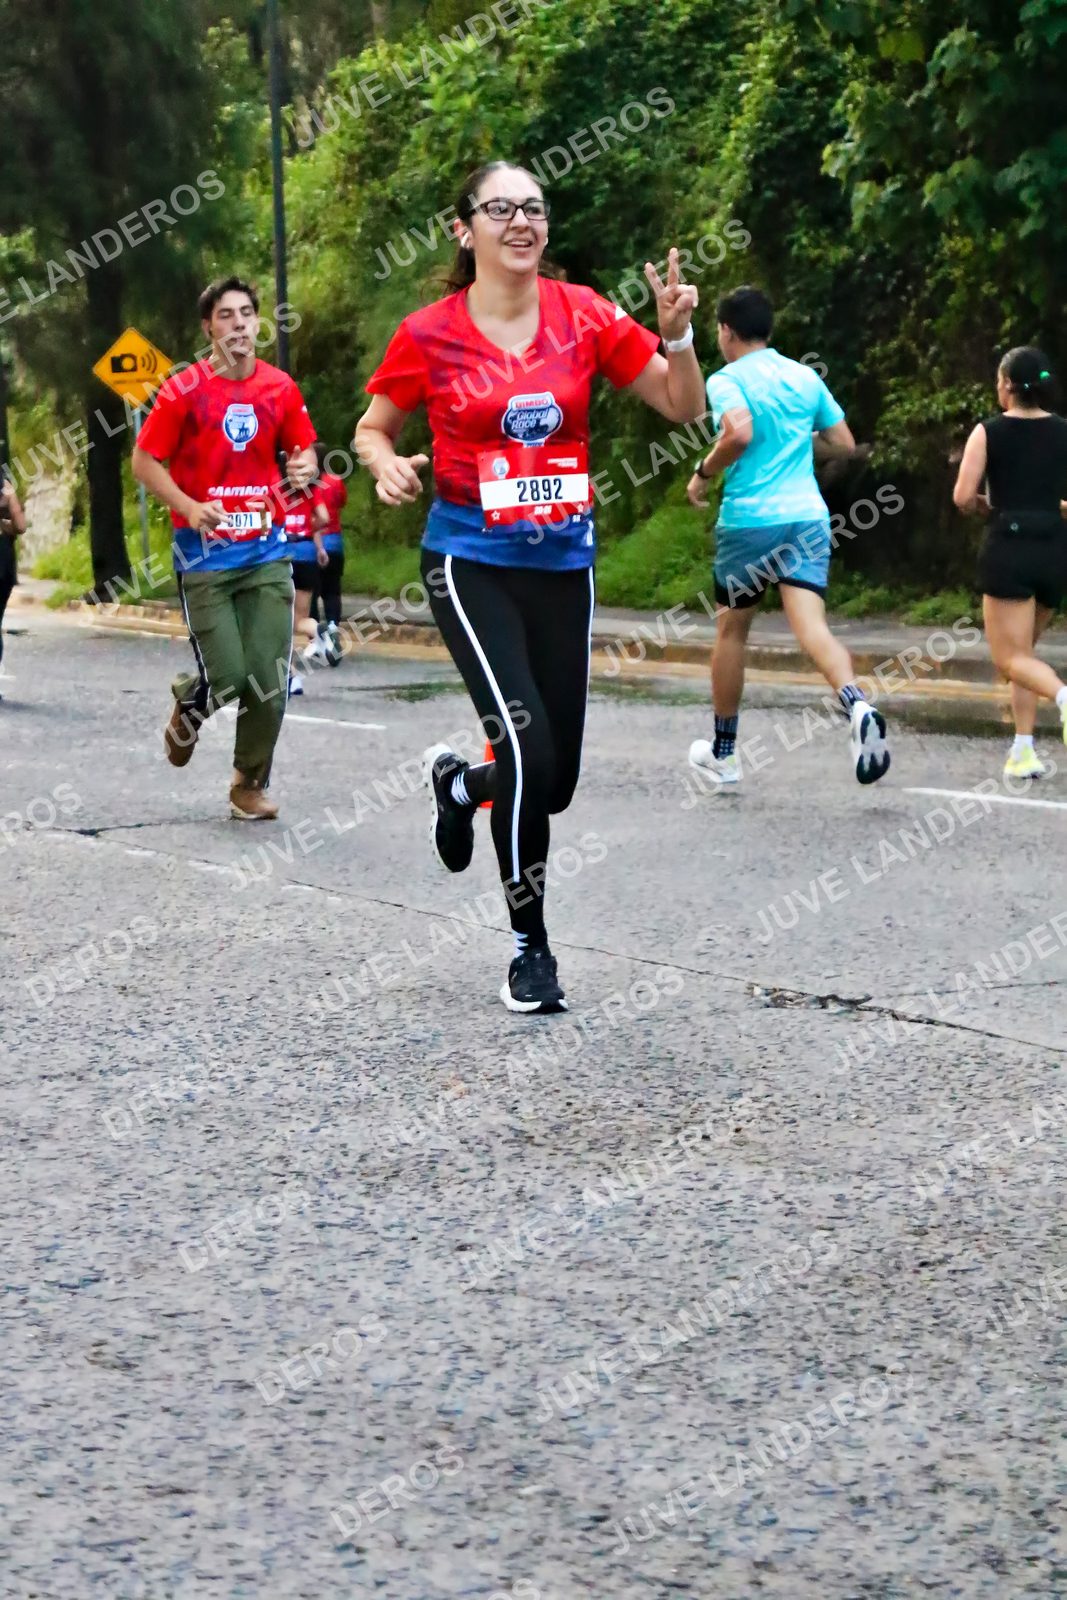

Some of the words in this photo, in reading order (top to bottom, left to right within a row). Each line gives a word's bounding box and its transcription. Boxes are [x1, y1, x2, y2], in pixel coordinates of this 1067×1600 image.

[516, 407, 549, 420] Global
[511, 419, 537, 430] Race
[516, 477, 563, 503] 2892
